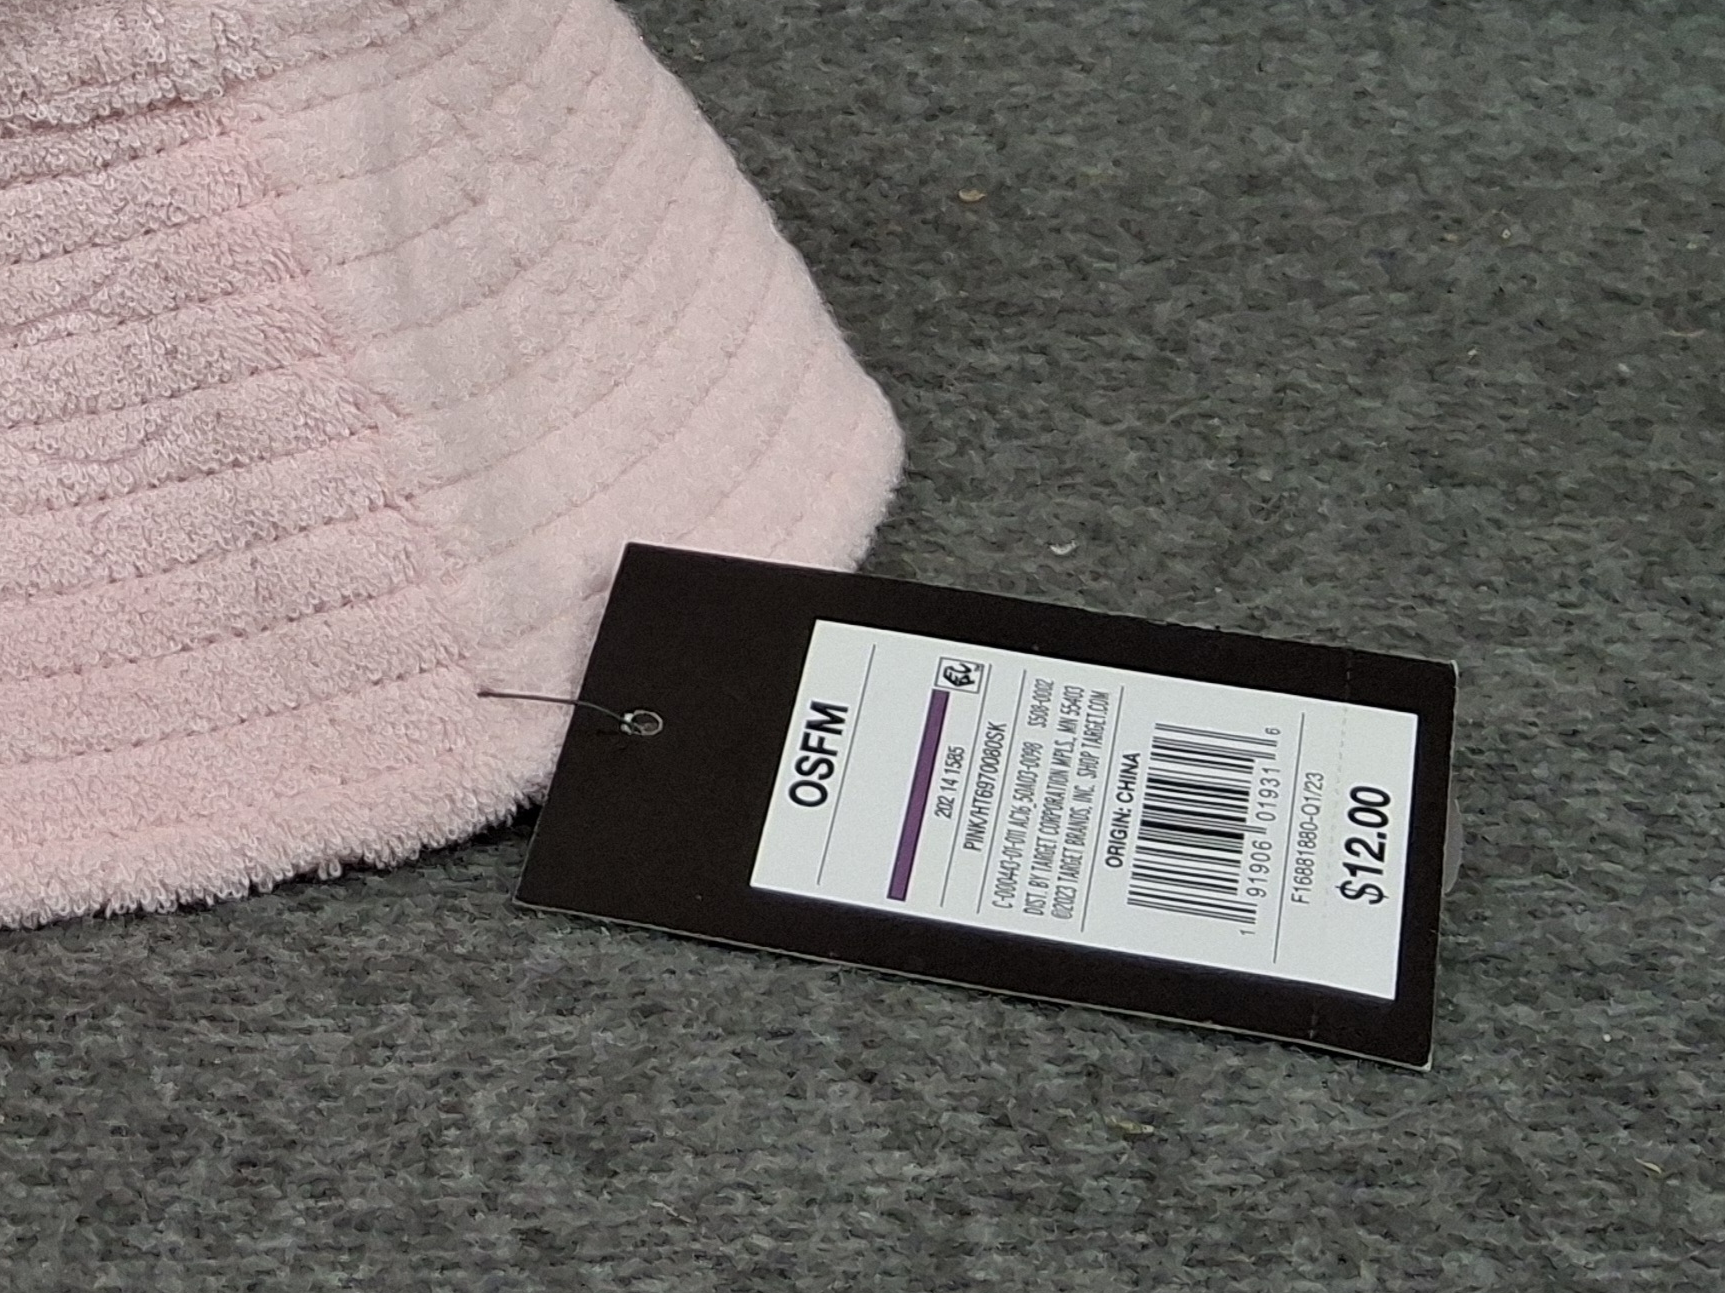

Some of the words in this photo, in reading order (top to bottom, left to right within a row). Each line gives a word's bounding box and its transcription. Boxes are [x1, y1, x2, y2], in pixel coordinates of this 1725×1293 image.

[1059, 685, 1085, 717] 55403
[1080, 690, 1109, 749] TARGET.COM
[1057, 717, 1078, 734] MN
[1264, 727, 1281, 736] 6
[788, 701, 849, 808] OSFM
[943, 745, 965, 775] 1585
[1076, 750, 1100, 779] SHOP
[939, 777, 959, 792] 14
[962, 721, 1007, 852] PINK/HT6970080SK
[1072, 784, 1096, 804] INC.
[1115, 752, 1141, 804] CHINA
[1255, 767, 1281, 822] 01931
[934, 795, 955, 820] 202
[1038, 768, 1069, 836] CORPORATION
[1064, 806, 1093, 847] BRANDS,
[1104, 807, 1132, 868] ORIGIN:
[1290, 772, 1325, 905] F16881880-Q1/23
[1335, 785, 1391, 905] $12.00
[1030, 835, 1058, 873] TARGET
[1056, 846, 1083, 884] TARGET
[1245, 840, 1273, 898] 91906
[1027, 873, 1050, 889] BY
[1022, 891, 1047, 916] DIST.
